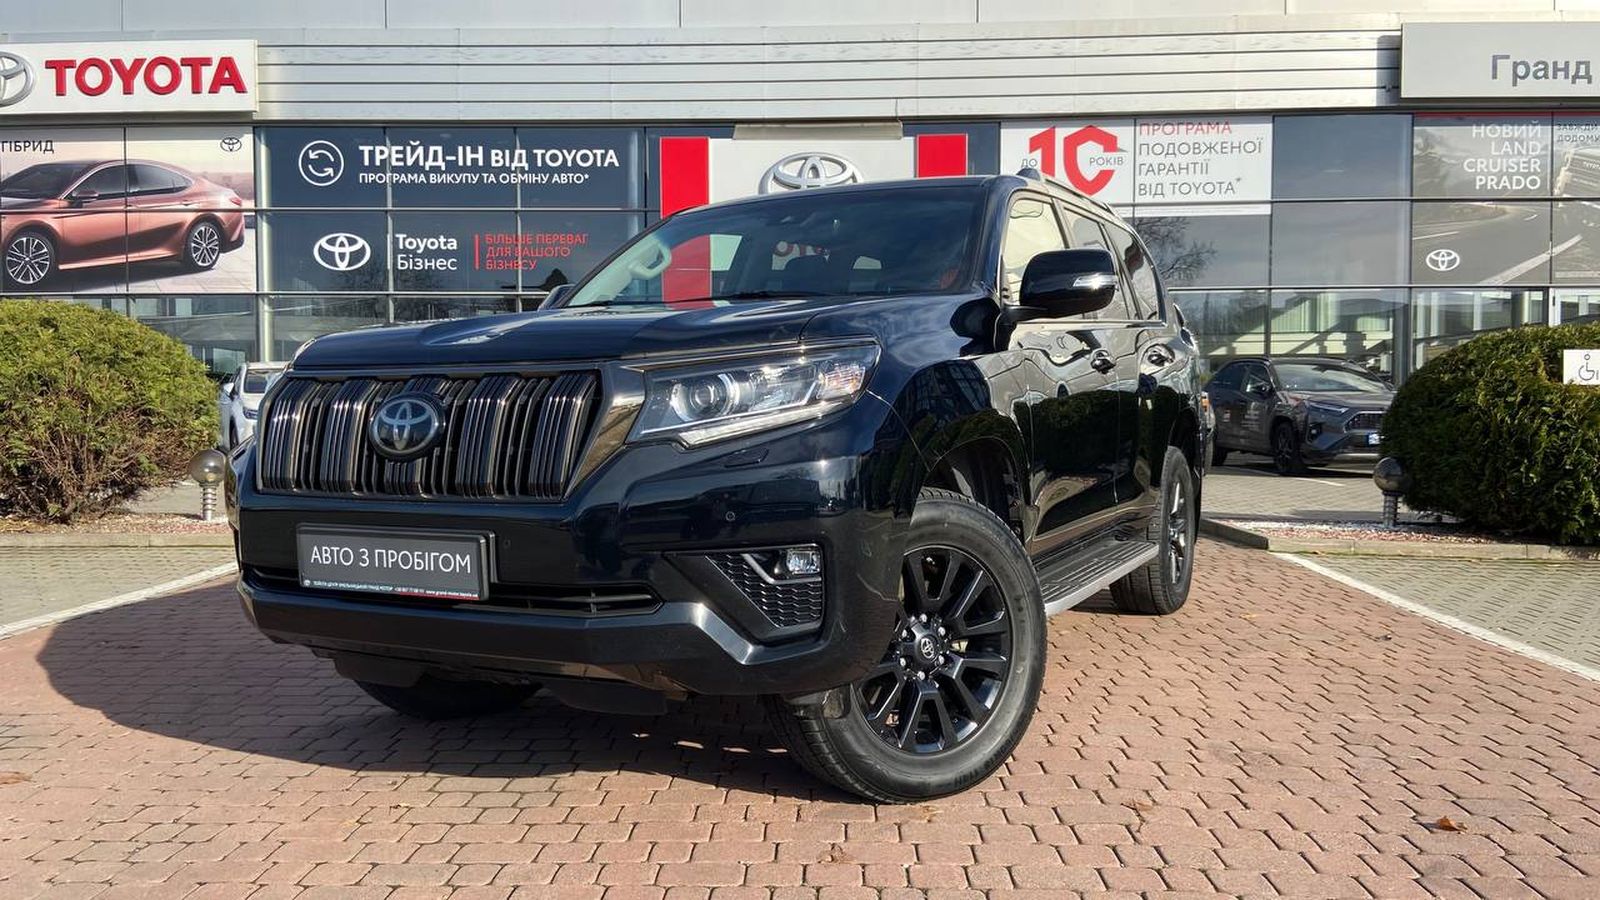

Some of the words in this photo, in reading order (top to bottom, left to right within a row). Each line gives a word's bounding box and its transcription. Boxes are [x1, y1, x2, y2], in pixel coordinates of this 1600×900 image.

[45, 56, 248, 96] TOYOTA
[1492, 54, 1592, 87] Гранд
[1139, 121, 1232, 136] ПРОГРАМА
[1472, 120, 1541, 138] НОВИЙ
[2, 140, 54, 153] ГІБРИД
[1139, 137, 1263, 158] ПОДОВЖЕНОЇ
[1491, 141, 1541, 155] LAND
[359, 140, 484, 171] ТРЕЙД-ІН
[490, 149, 529, 171] ВІД
[533, 149, 619, 167] TOYOTA
[1021, 158, 1038, 168] ДО
[1089, 156, 1124, 167] РОКІВ
[1138, 159, 1210, 176] ГАРАНТІЇ
[1463, 158, 1541, 172] CRUISER
[359, 173, 427, 184] ПРОГРАМА
[429, 173, 480, 184] ВИКУПУ
[481, 173, 497, 184] ТА
[499, 173, 550, 184] ОБМІНУ
[1475, 175, 1541, 190] PRADO
[1138, 183, 1165, 198] ВІД
[395, 234, 457, 253] Toyota
[485, 234, 532, 244] БІЛЬШЕ
[536, 234, 589, 244] ПЕРЕВАГ
[485, 247, 511, 258] ДЛЯ
[515, 247, 571, 257] ВАШОГО
[397, 254, 457, 270] Бізнес
[485, 260, 537, 270] БІЗНЕСУ
[311, 546, 354, 566] АВТО
[375, 550, 471, 574] ПРОБІГОМ
